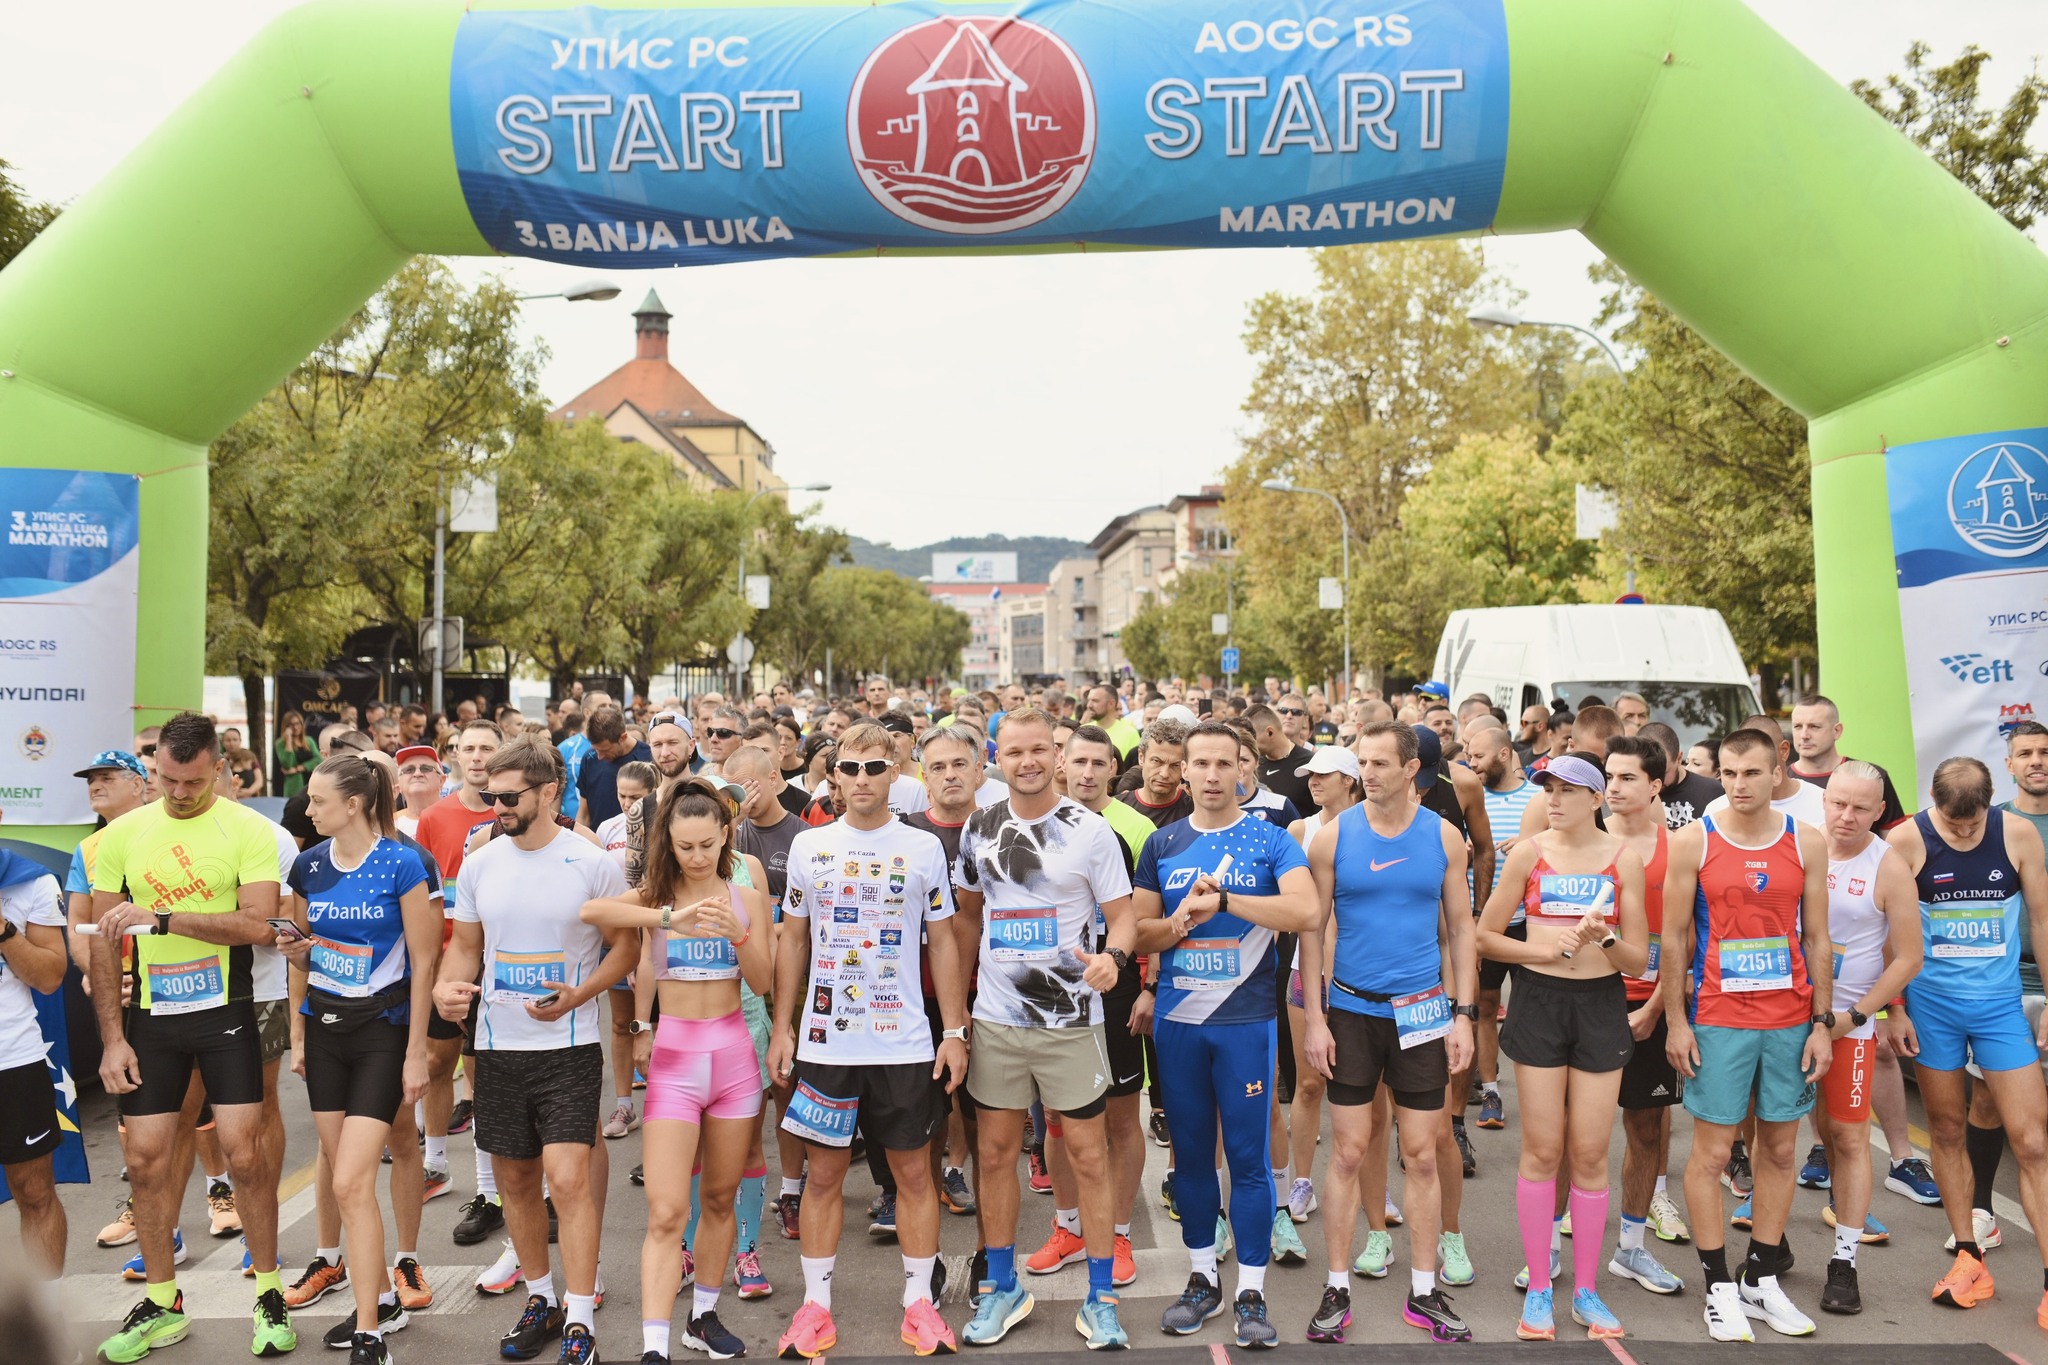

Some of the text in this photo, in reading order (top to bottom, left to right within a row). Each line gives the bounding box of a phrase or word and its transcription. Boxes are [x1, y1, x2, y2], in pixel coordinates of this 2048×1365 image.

[1194, 13, 1413, 53] AOGC RS
[551, 36, 749, 71] УПИС РС
[1144, 68, 1464, 160] START
[495, 90, 801, 175] START
[1219, 196, 1456, 233] MARATHON
[683, 216, 794, 246] LUKA
[31, 511, 66, 522] УПИС
[31, 522, 107, 534] BANJA LUKA
[9, 532, 108, 548] MARATHON
[1988, 612, 2027, 627] УПИС
[40, 640, 56, 650] RS
[1972, 659, 2014, 684] eft
[1557, 877, 1597, 896] 3027
[1933, 889, 2006, 901] AD OLIMPIK
[328, 902, 384, 920] banka
[1003, 921, 1039, 942] 4051
[1946, 921, 1990, 939] 2004
[685, 940, 722, 960] 1031
[321, 951, 354, 976] 3036
[1186, 952, 1223, 971] 3015
[1737, 952, 1773, 972] 2151
[162, 973, 206, 996] 3003
[508, 966, 547, 985] 1054
[869, 1001, 903, 1009] NERKO
[1410, 1000, 1441, 1025] 4028
[1849, 1039, 1864, 1108] POLSKA
[802, 1104, 841, 1129] 4041
